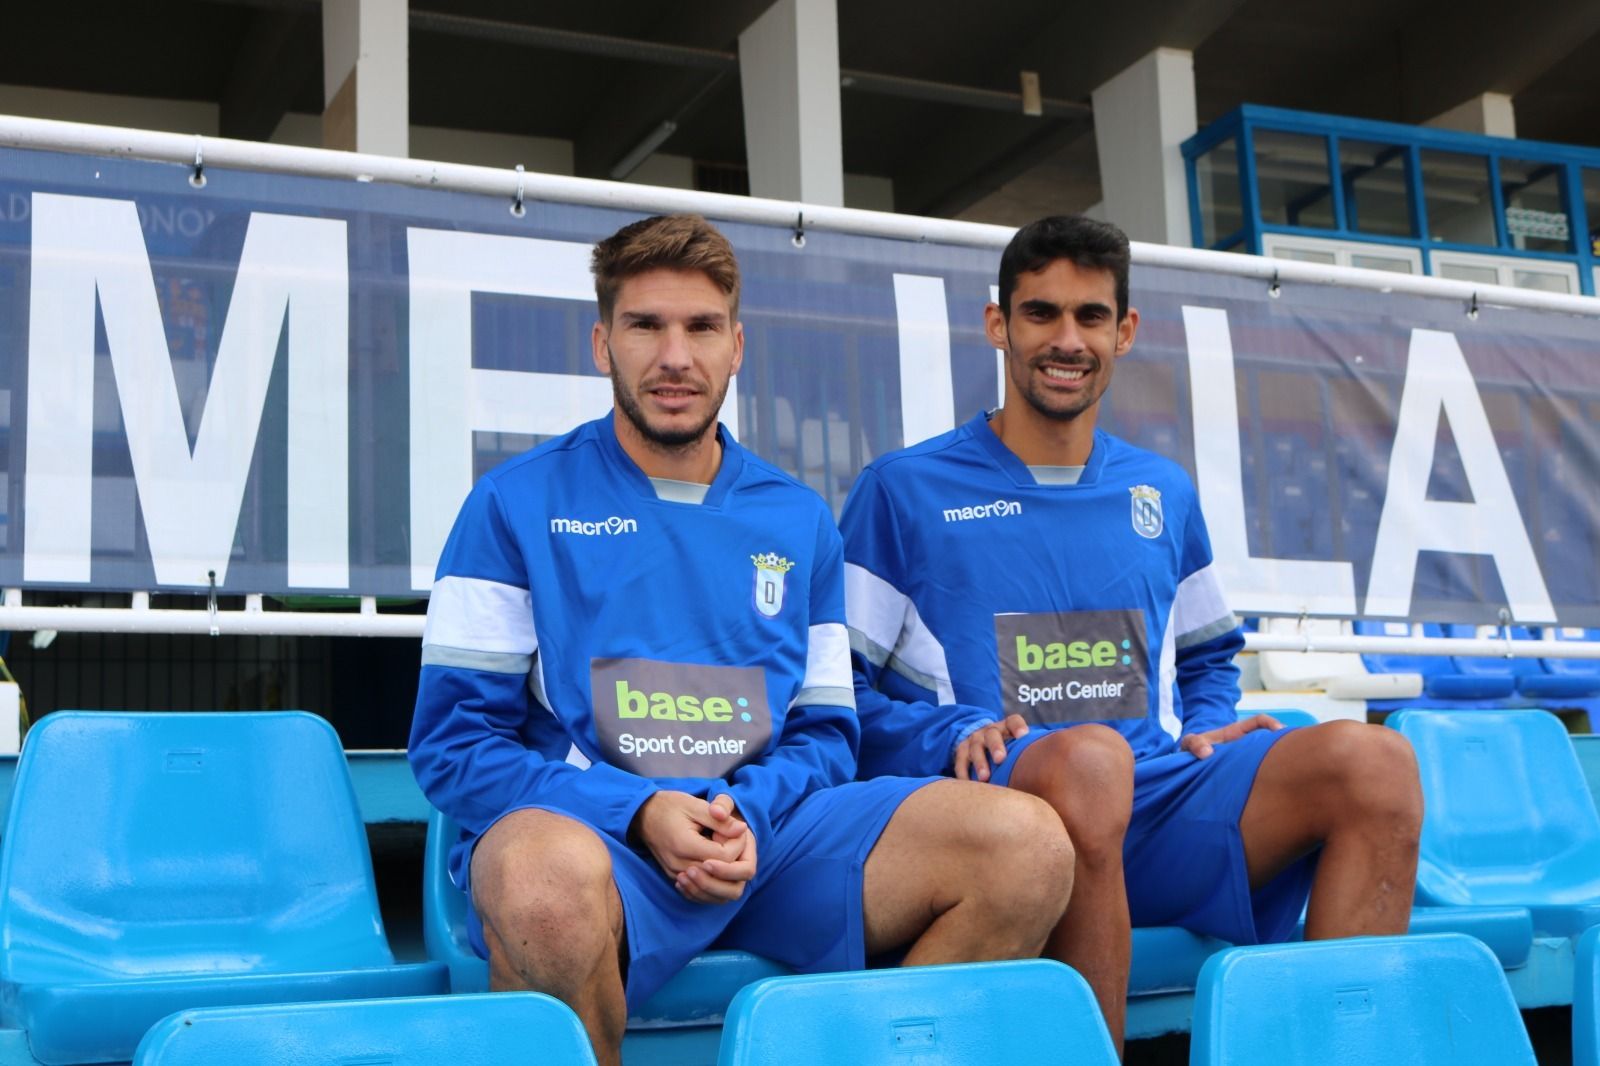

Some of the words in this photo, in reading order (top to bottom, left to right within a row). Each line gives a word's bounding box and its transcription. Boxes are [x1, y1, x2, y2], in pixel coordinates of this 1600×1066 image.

[943, 500, 1022, 522] macron
[550, 516, 637, 536] macron
[1017, 682, 1063, 706] Sport
[1065, 680, 1125, 700] Center
[618, 733, 675, 756] Sport
[678, 735, 747, 755] Center
